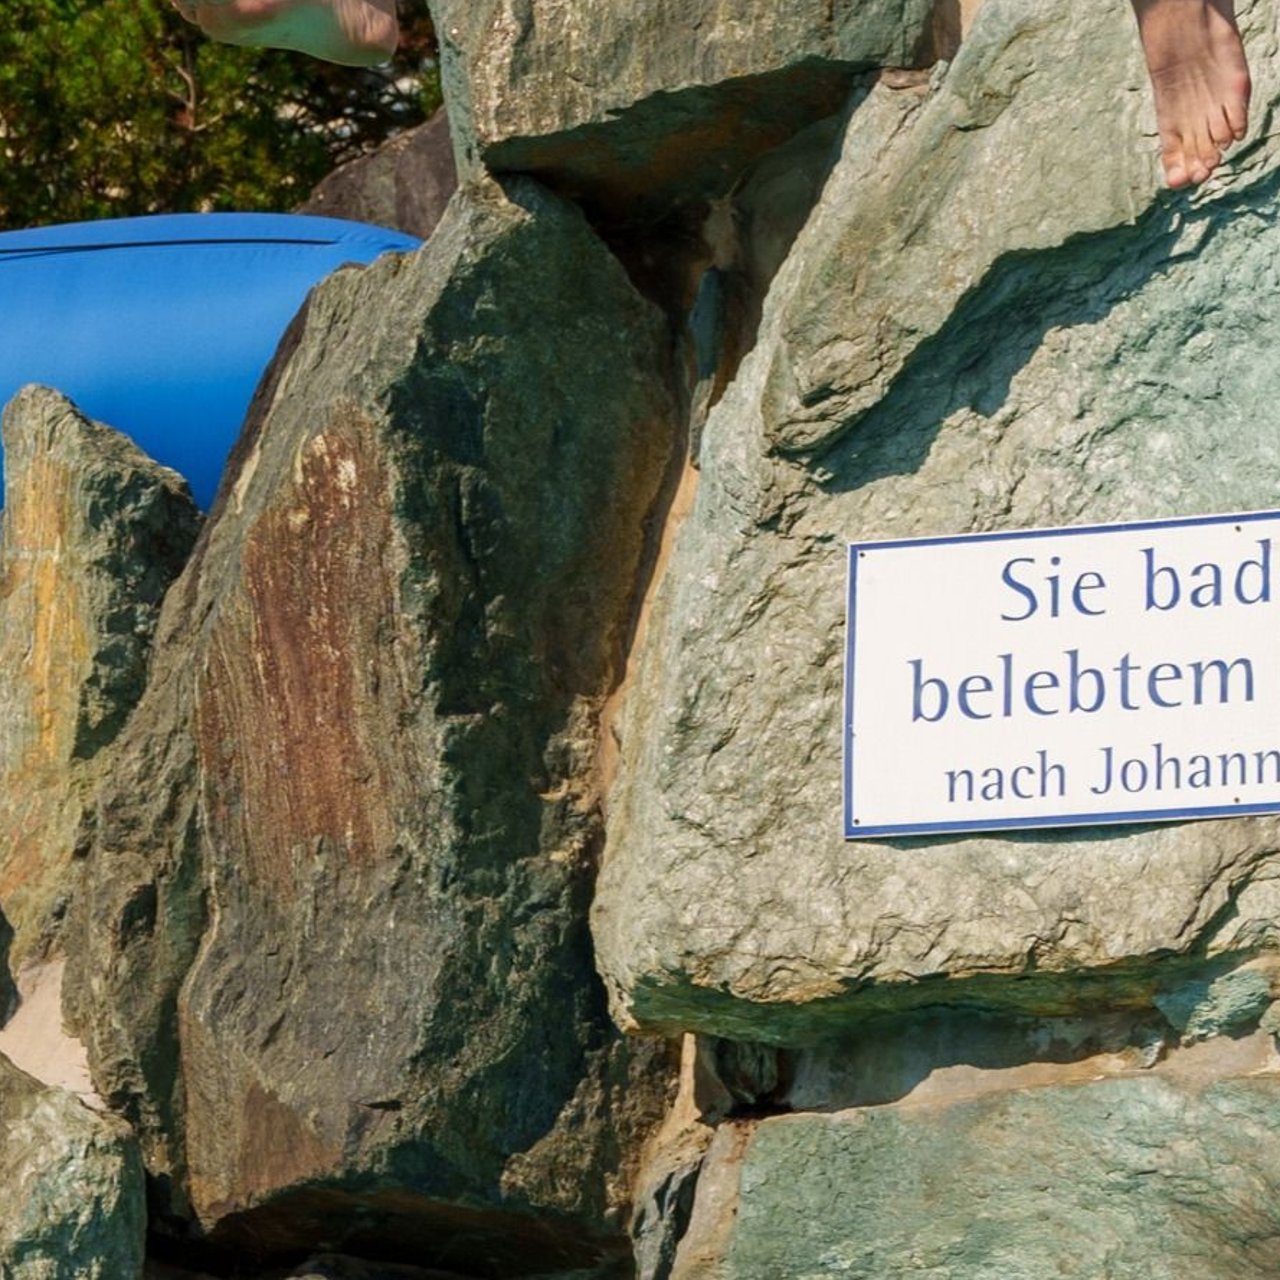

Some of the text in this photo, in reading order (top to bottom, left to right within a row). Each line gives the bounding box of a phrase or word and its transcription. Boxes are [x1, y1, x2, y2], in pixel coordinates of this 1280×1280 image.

[1000, 557, 1107, 622] Sie
[909, 647, 1256, 723] belebtem
[945, 750, 1067, 803] nach
